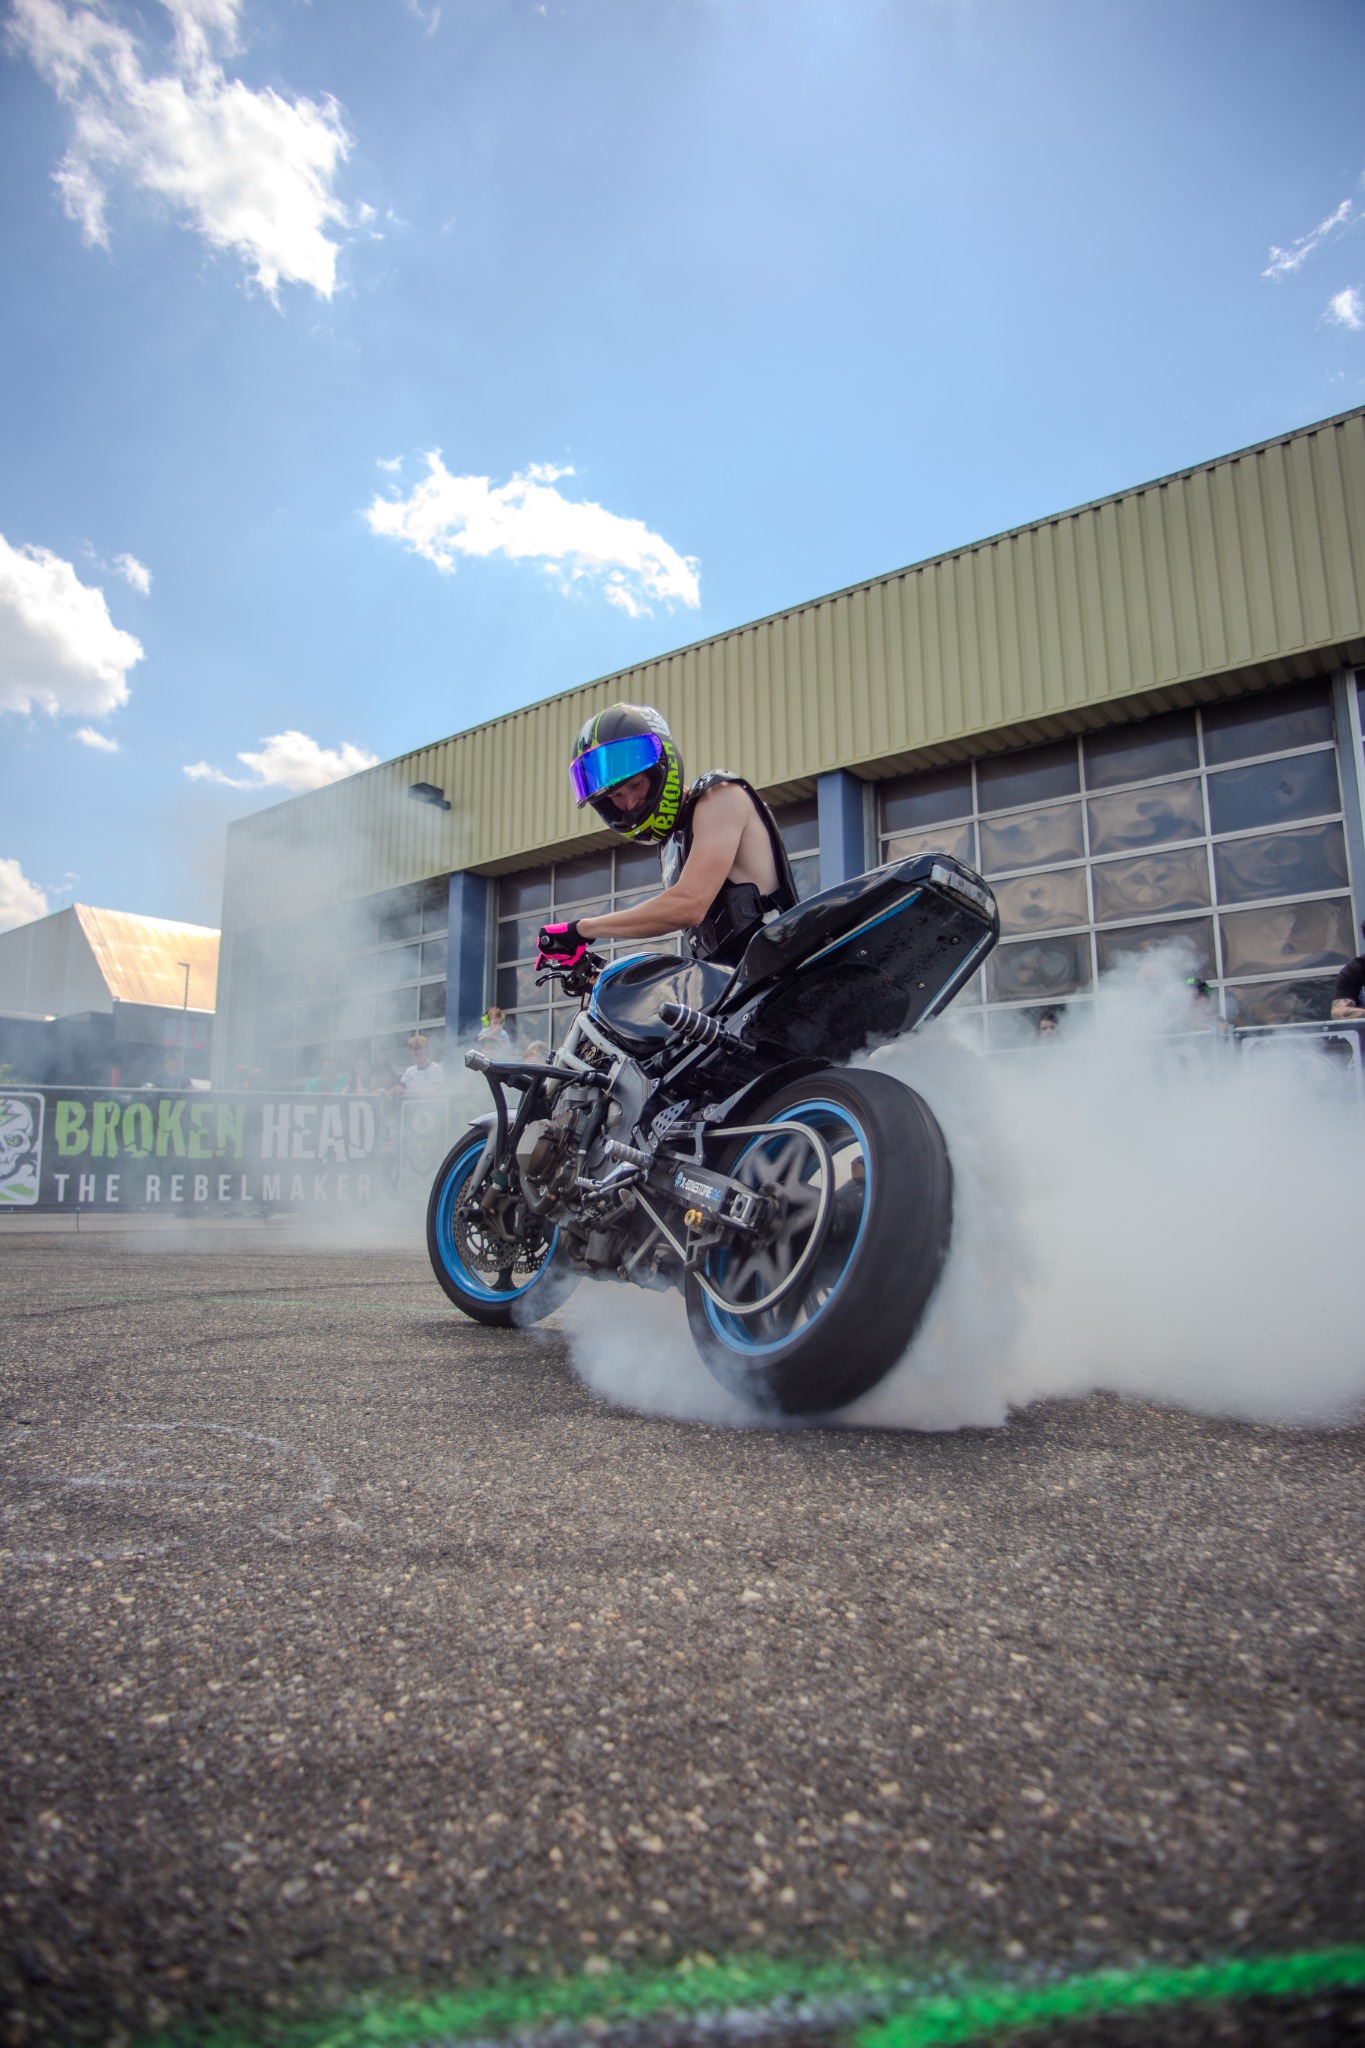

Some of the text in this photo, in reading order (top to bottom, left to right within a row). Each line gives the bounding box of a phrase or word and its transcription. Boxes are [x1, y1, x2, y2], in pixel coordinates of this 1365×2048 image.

[54, 1099, 376, 1163] BROKEN HEAD
[54, 1173, 372, 1203] THE REBELMAKER
